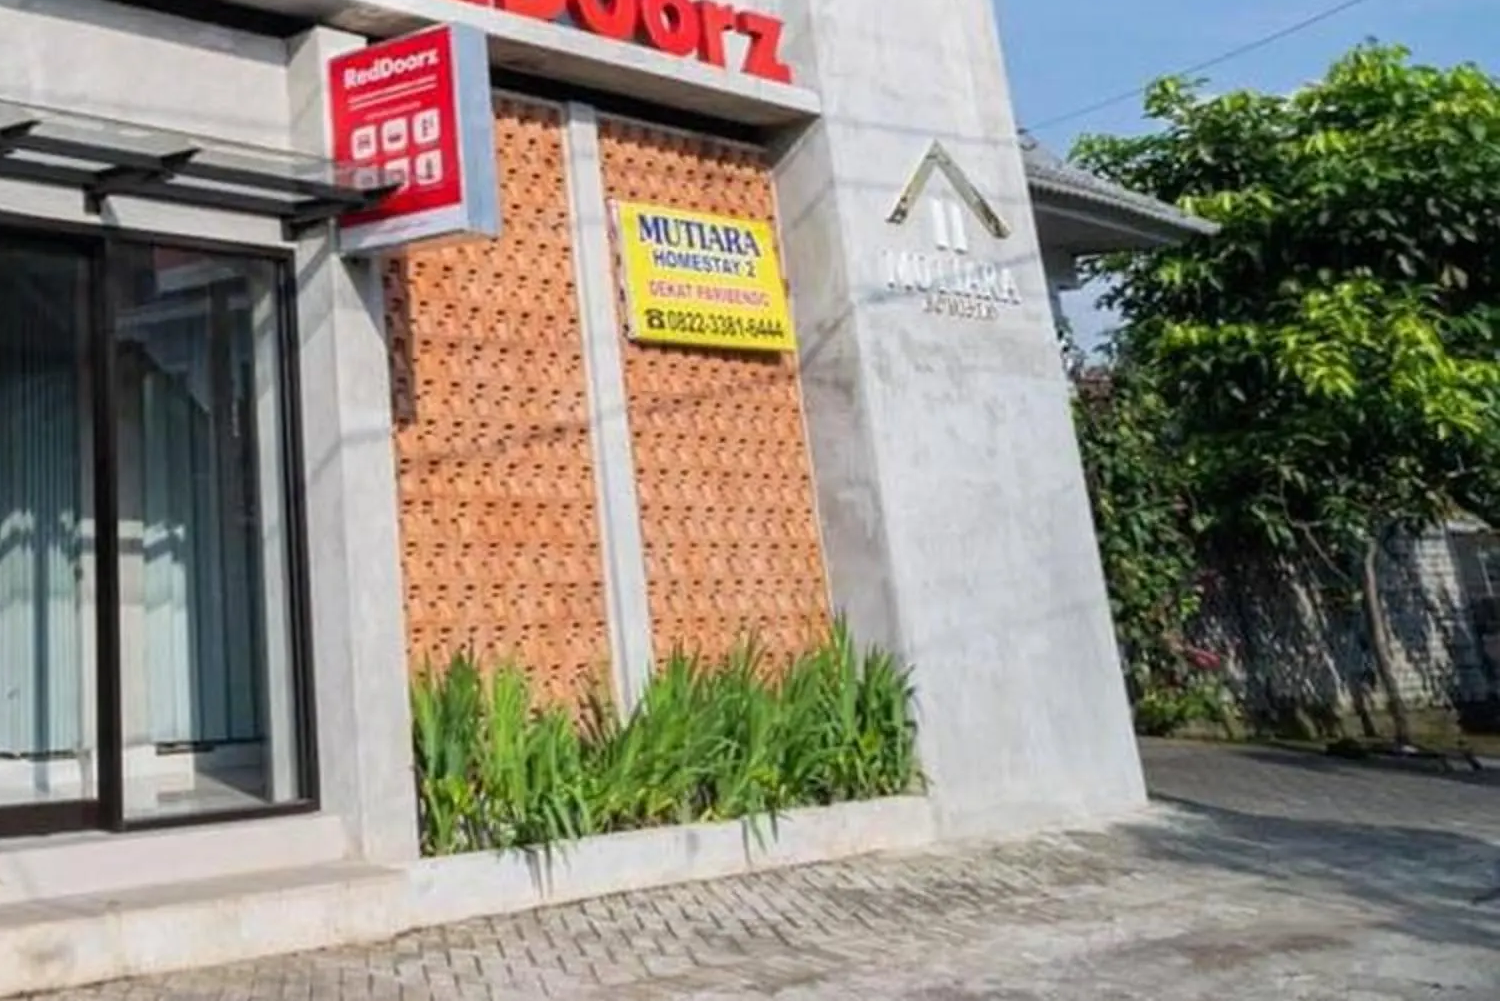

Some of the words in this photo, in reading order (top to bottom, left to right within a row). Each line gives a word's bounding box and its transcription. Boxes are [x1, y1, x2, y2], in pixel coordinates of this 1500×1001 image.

[343, 49, 439, 89] RedDoorz
[637, 214, 761, 257] MUTIARA
[653, 249, 741, 275] HOMESTAY
